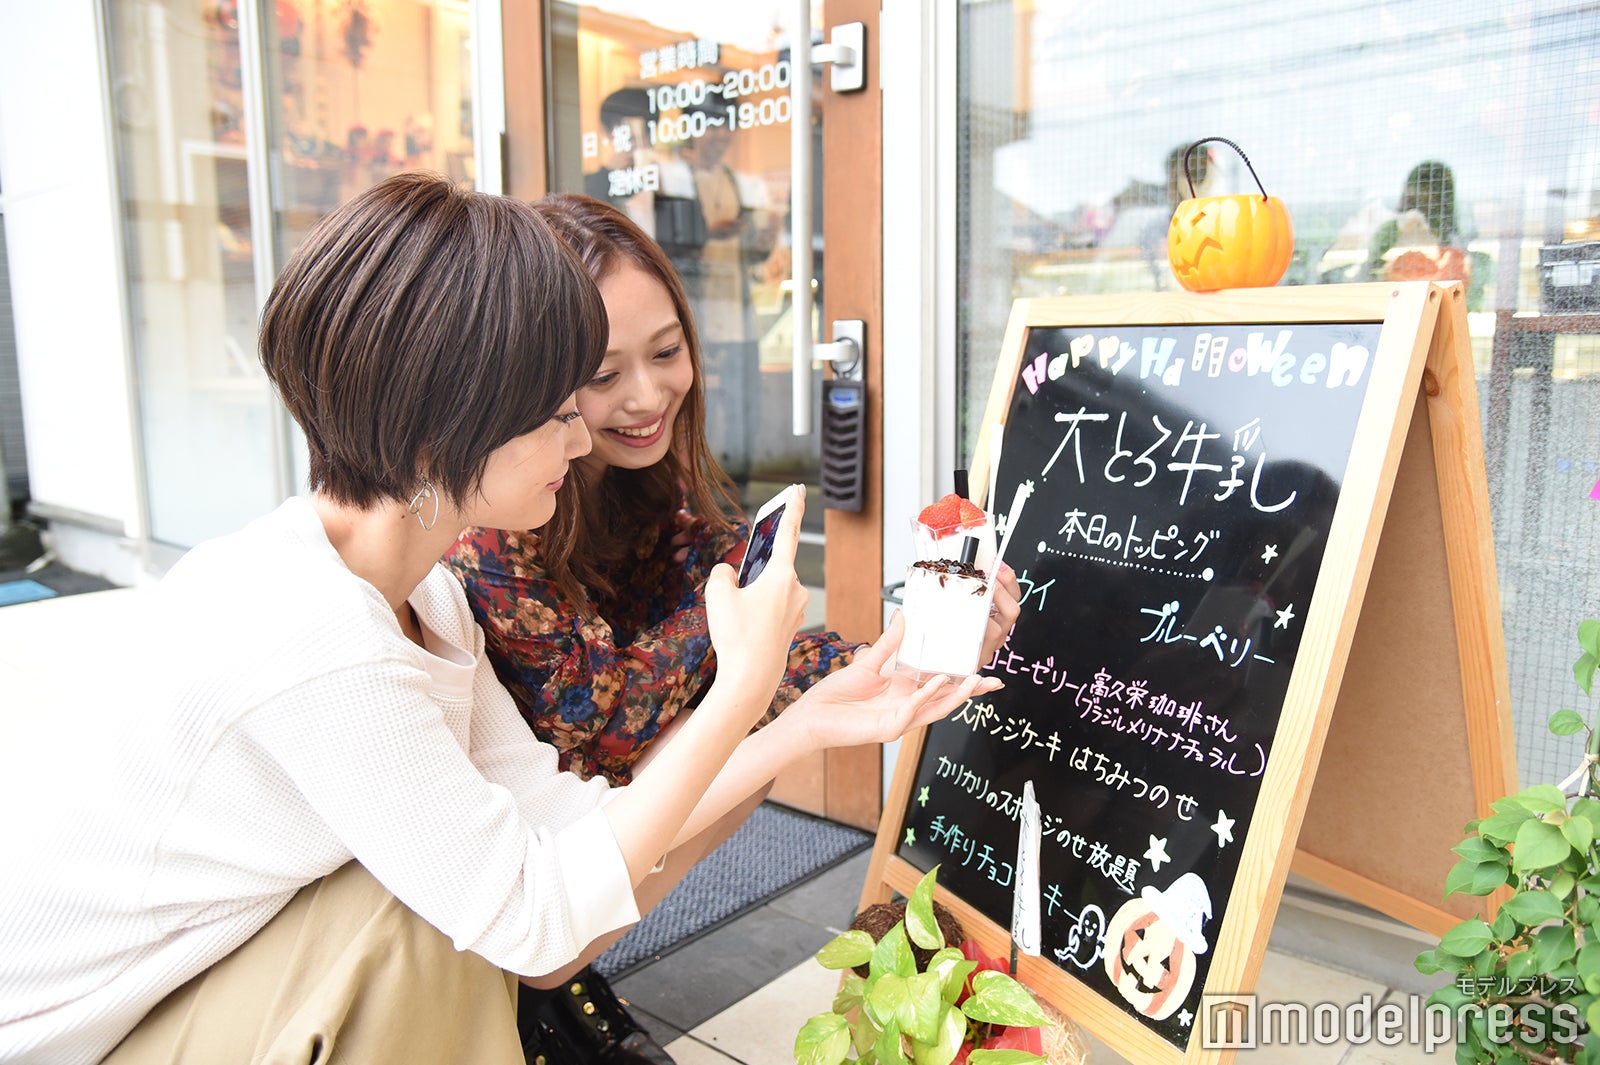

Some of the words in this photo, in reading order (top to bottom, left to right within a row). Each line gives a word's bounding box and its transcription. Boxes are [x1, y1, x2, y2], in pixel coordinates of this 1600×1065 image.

[639, 38, 718, 80] 営業時間
[1041, 406, 1297, 513] 大とろ牛乳
[1059, 508, 1220, 563] 本日のトッピング
[1140, 600, 1275, 668] ブルーベリー
